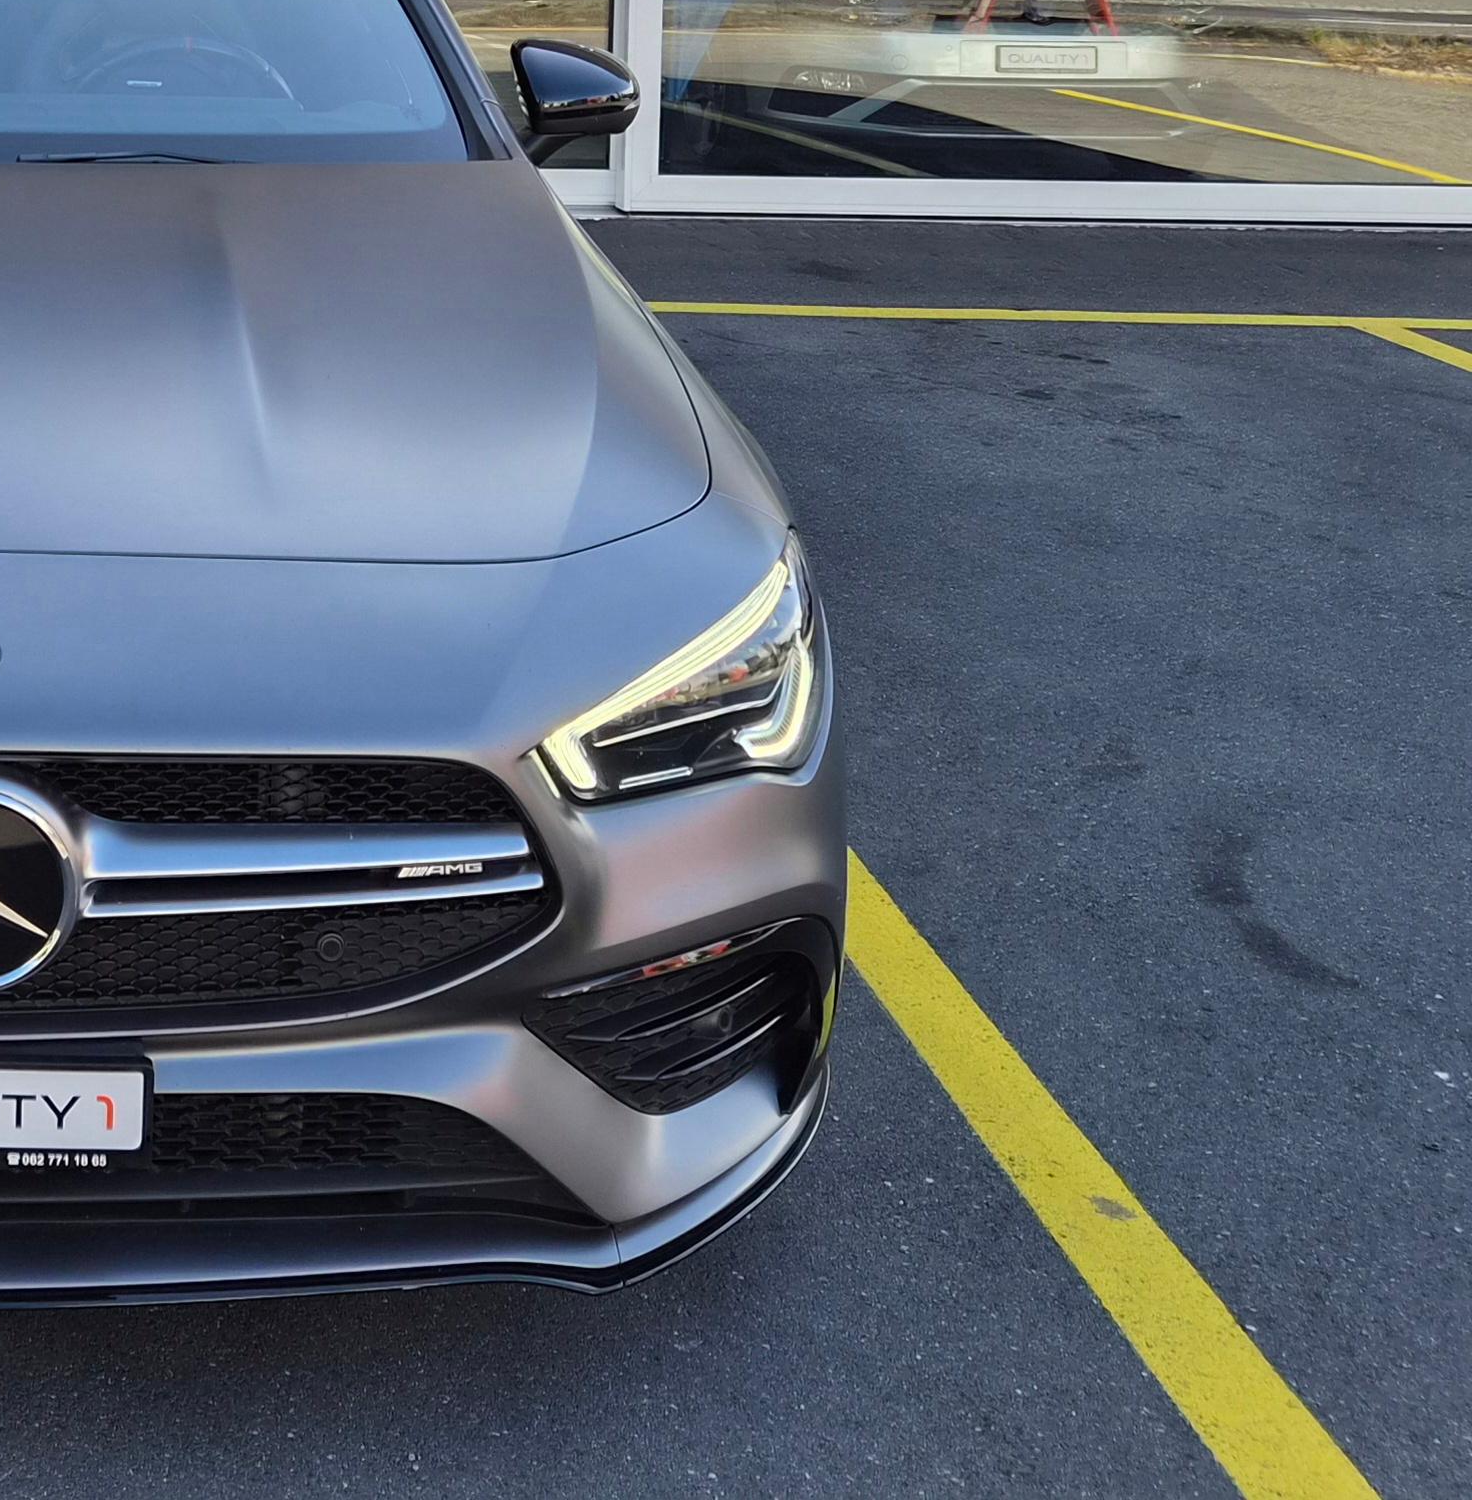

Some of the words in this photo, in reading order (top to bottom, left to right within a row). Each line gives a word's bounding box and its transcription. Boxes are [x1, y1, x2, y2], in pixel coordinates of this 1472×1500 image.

[1008, 53, 1080, 65] QUALITY
[425, 862, 483, 876] AMG
[47, 1153, 69, 1167] 771
